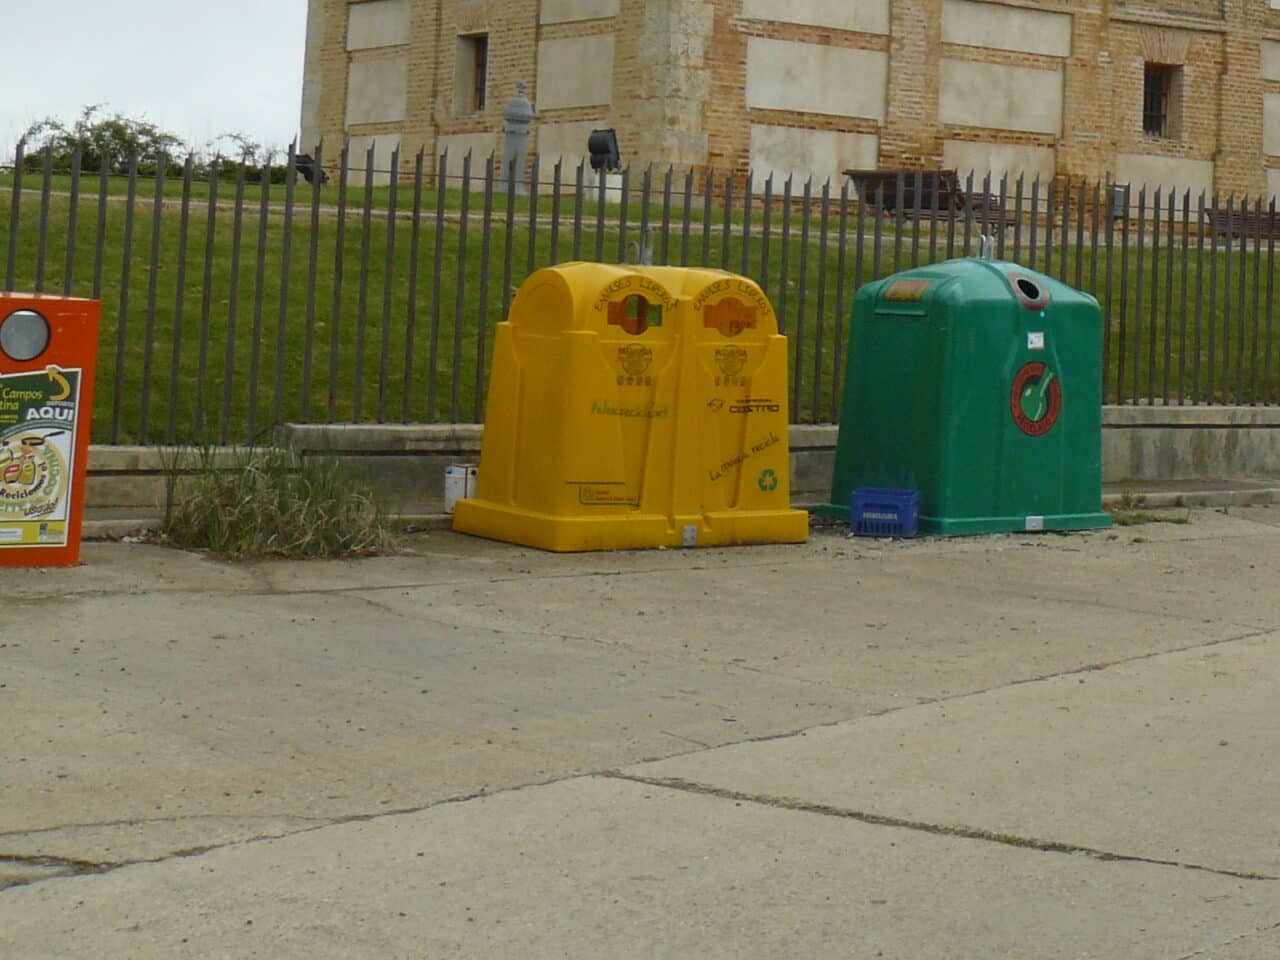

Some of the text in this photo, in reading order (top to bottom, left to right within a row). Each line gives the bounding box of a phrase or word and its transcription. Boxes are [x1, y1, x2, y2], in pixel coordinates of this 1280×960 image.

[2, 387, 43, 402] Campos
[0, 399, 19, 410] tina
[26, 406, 74, 420] AQUI
